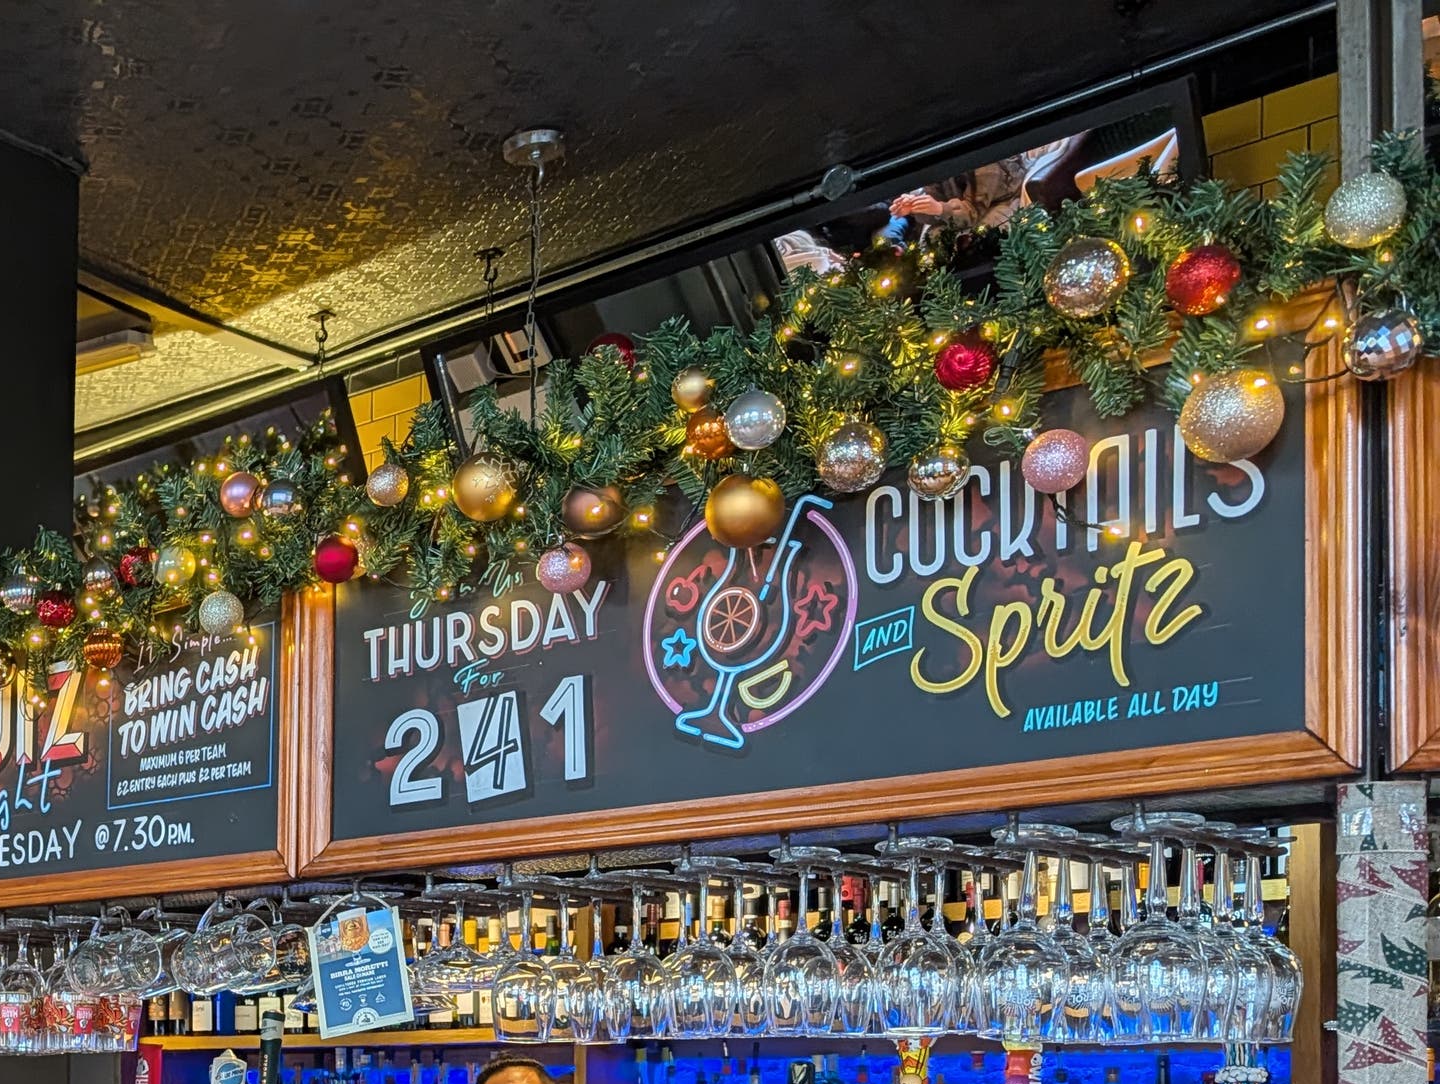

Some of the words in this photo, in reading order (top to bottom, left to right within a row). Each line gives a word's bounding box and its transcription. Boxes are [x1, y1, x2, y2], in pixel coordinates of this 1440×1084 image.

[364, 580, 610, 681] THURSDAY
[862, 617, 909, 655] AND
[909, 540, 1203, 719] Spritz
[124, 667, 192, 717] BRING
[196, 645, 260, 695] CASH
[453, 659, 504, 694] For
[1023, 697, 1121, 733] AVAILABLE
[1127, 691, 1166, 719] ALL
[1171, 680, 1220, 713] DAY
[118, 719, 147, 757] TO
[150, 701, 197, 748] WIN
[201, 677, 268, 732] CASH
[129, 775, 156, 793] ENTRY
[157, 773, 178, 788] EACH
[178, 770, 196, 786] PLUS
[198, 767, 210, 783] £2
[211, 765, 226, 781] PER
[227, 761, 252, 777] TEAM
[140, 753, 178, 772] MAXIMUM
[178, 752, 184, 766] 6
[185, 749, 200, 764] PER
[201, 743, 227, 762] TEAM
